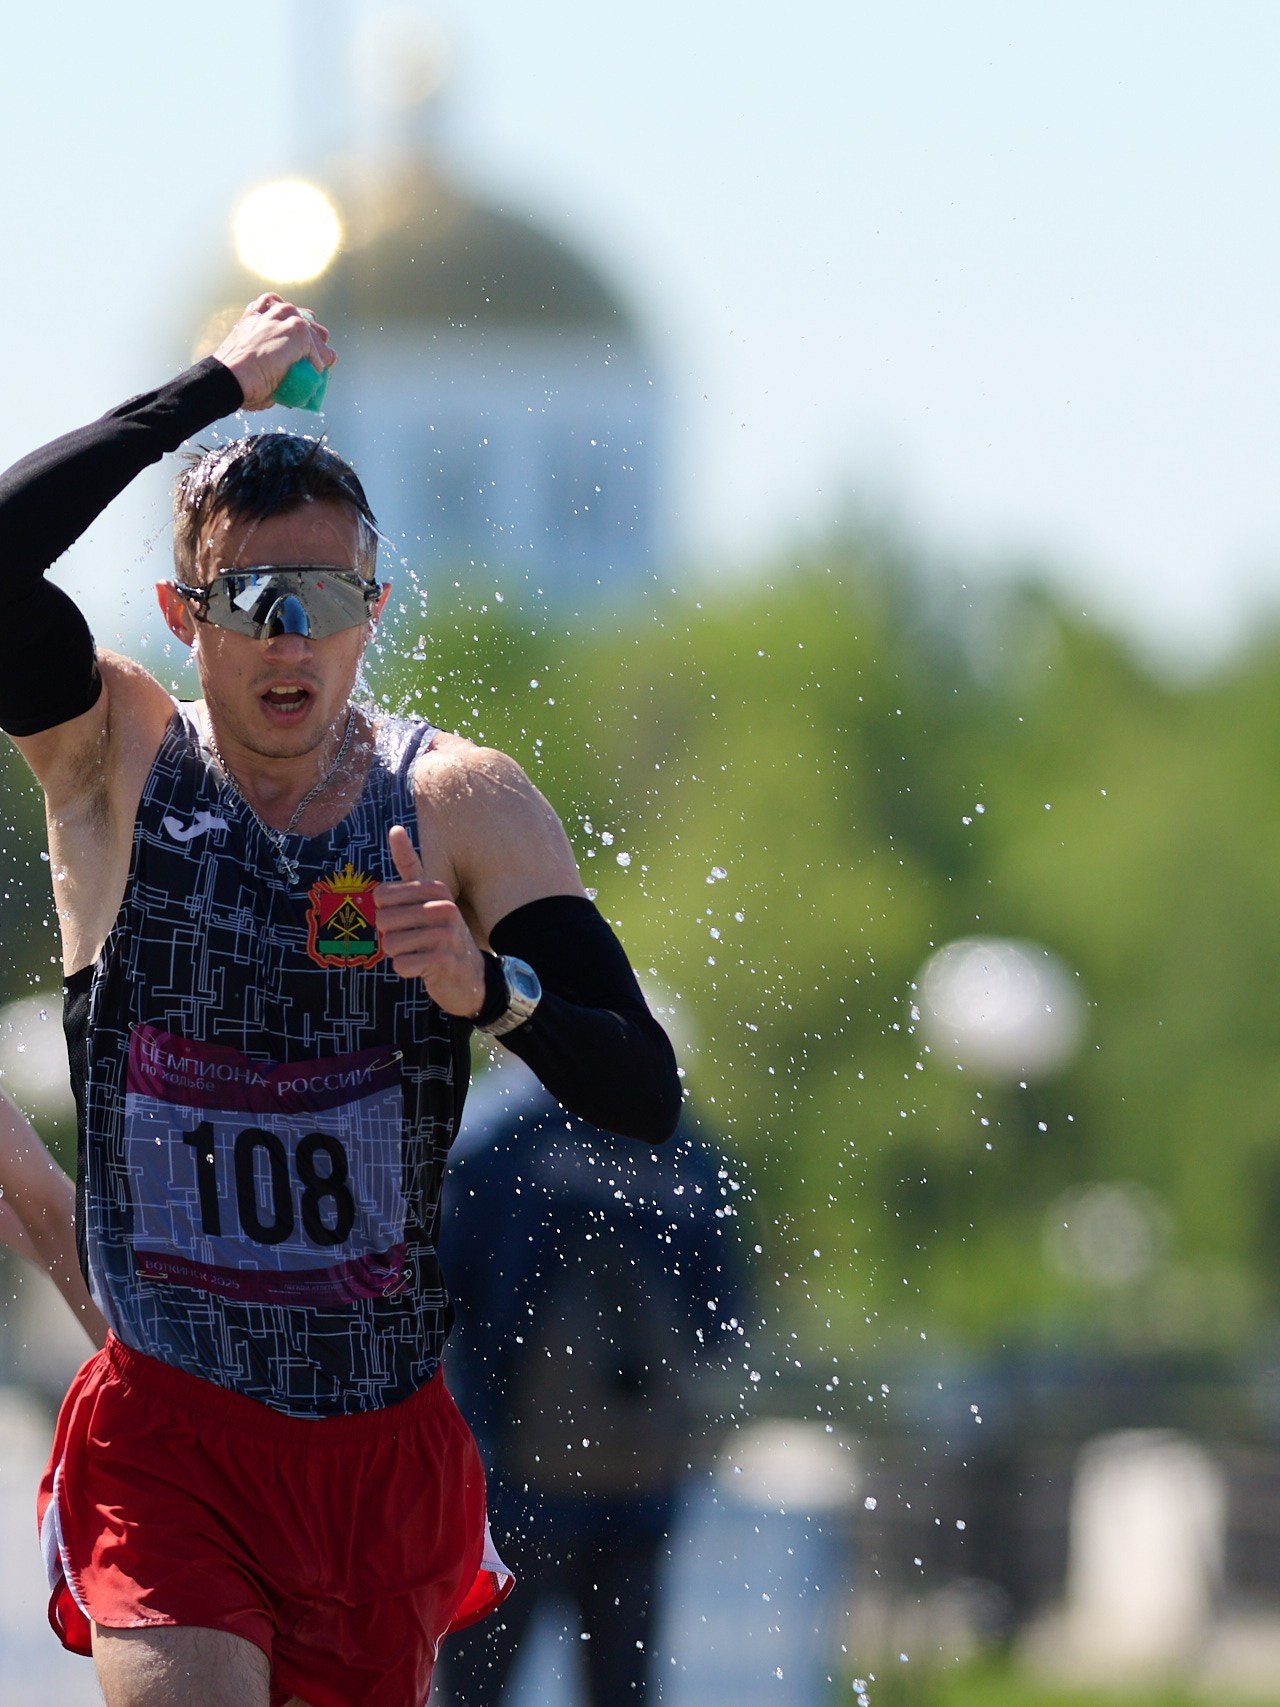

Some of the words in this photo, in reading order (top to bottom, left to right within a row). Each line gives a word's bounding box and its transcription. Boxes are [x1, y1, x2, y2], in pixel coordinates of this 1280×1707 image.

[140, 1062, 156, 1076] по
[161, 1070, 215, 1092] ходьбе
[141, 1042, 270, 1088] ЧЕМПИОНА
[277, 1067, 372, 1096] РОССИИ
[182, 1120, 355, 1247] 108
[210, 1275, 240, 1289] 2025
